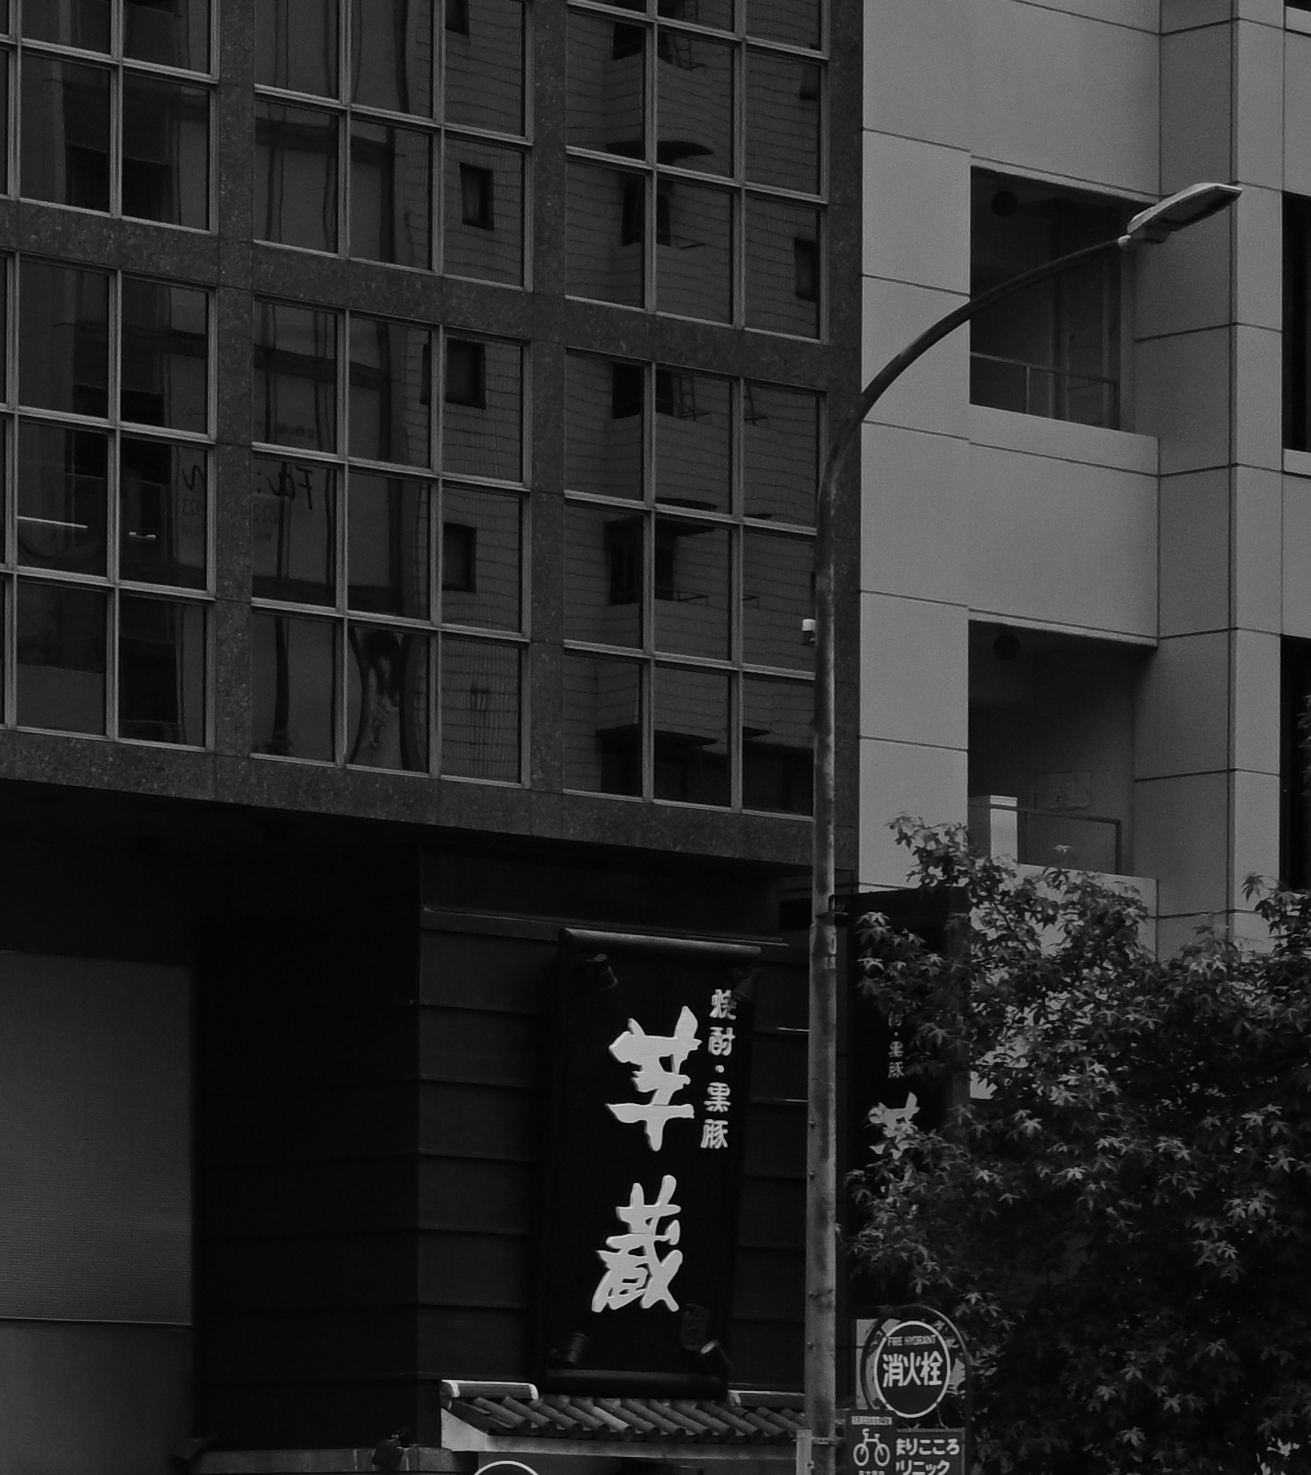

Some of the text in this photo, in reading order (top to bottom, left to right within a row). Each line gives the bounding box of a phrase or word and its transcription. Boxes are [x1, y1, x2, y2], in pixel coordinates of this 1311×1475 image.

[590, 1005, 703, 1314] 芋蔵
[887, 1335, 936, 1346] FIRE HYDRANT
[882, 1350, 943, 1388] 消火栓
